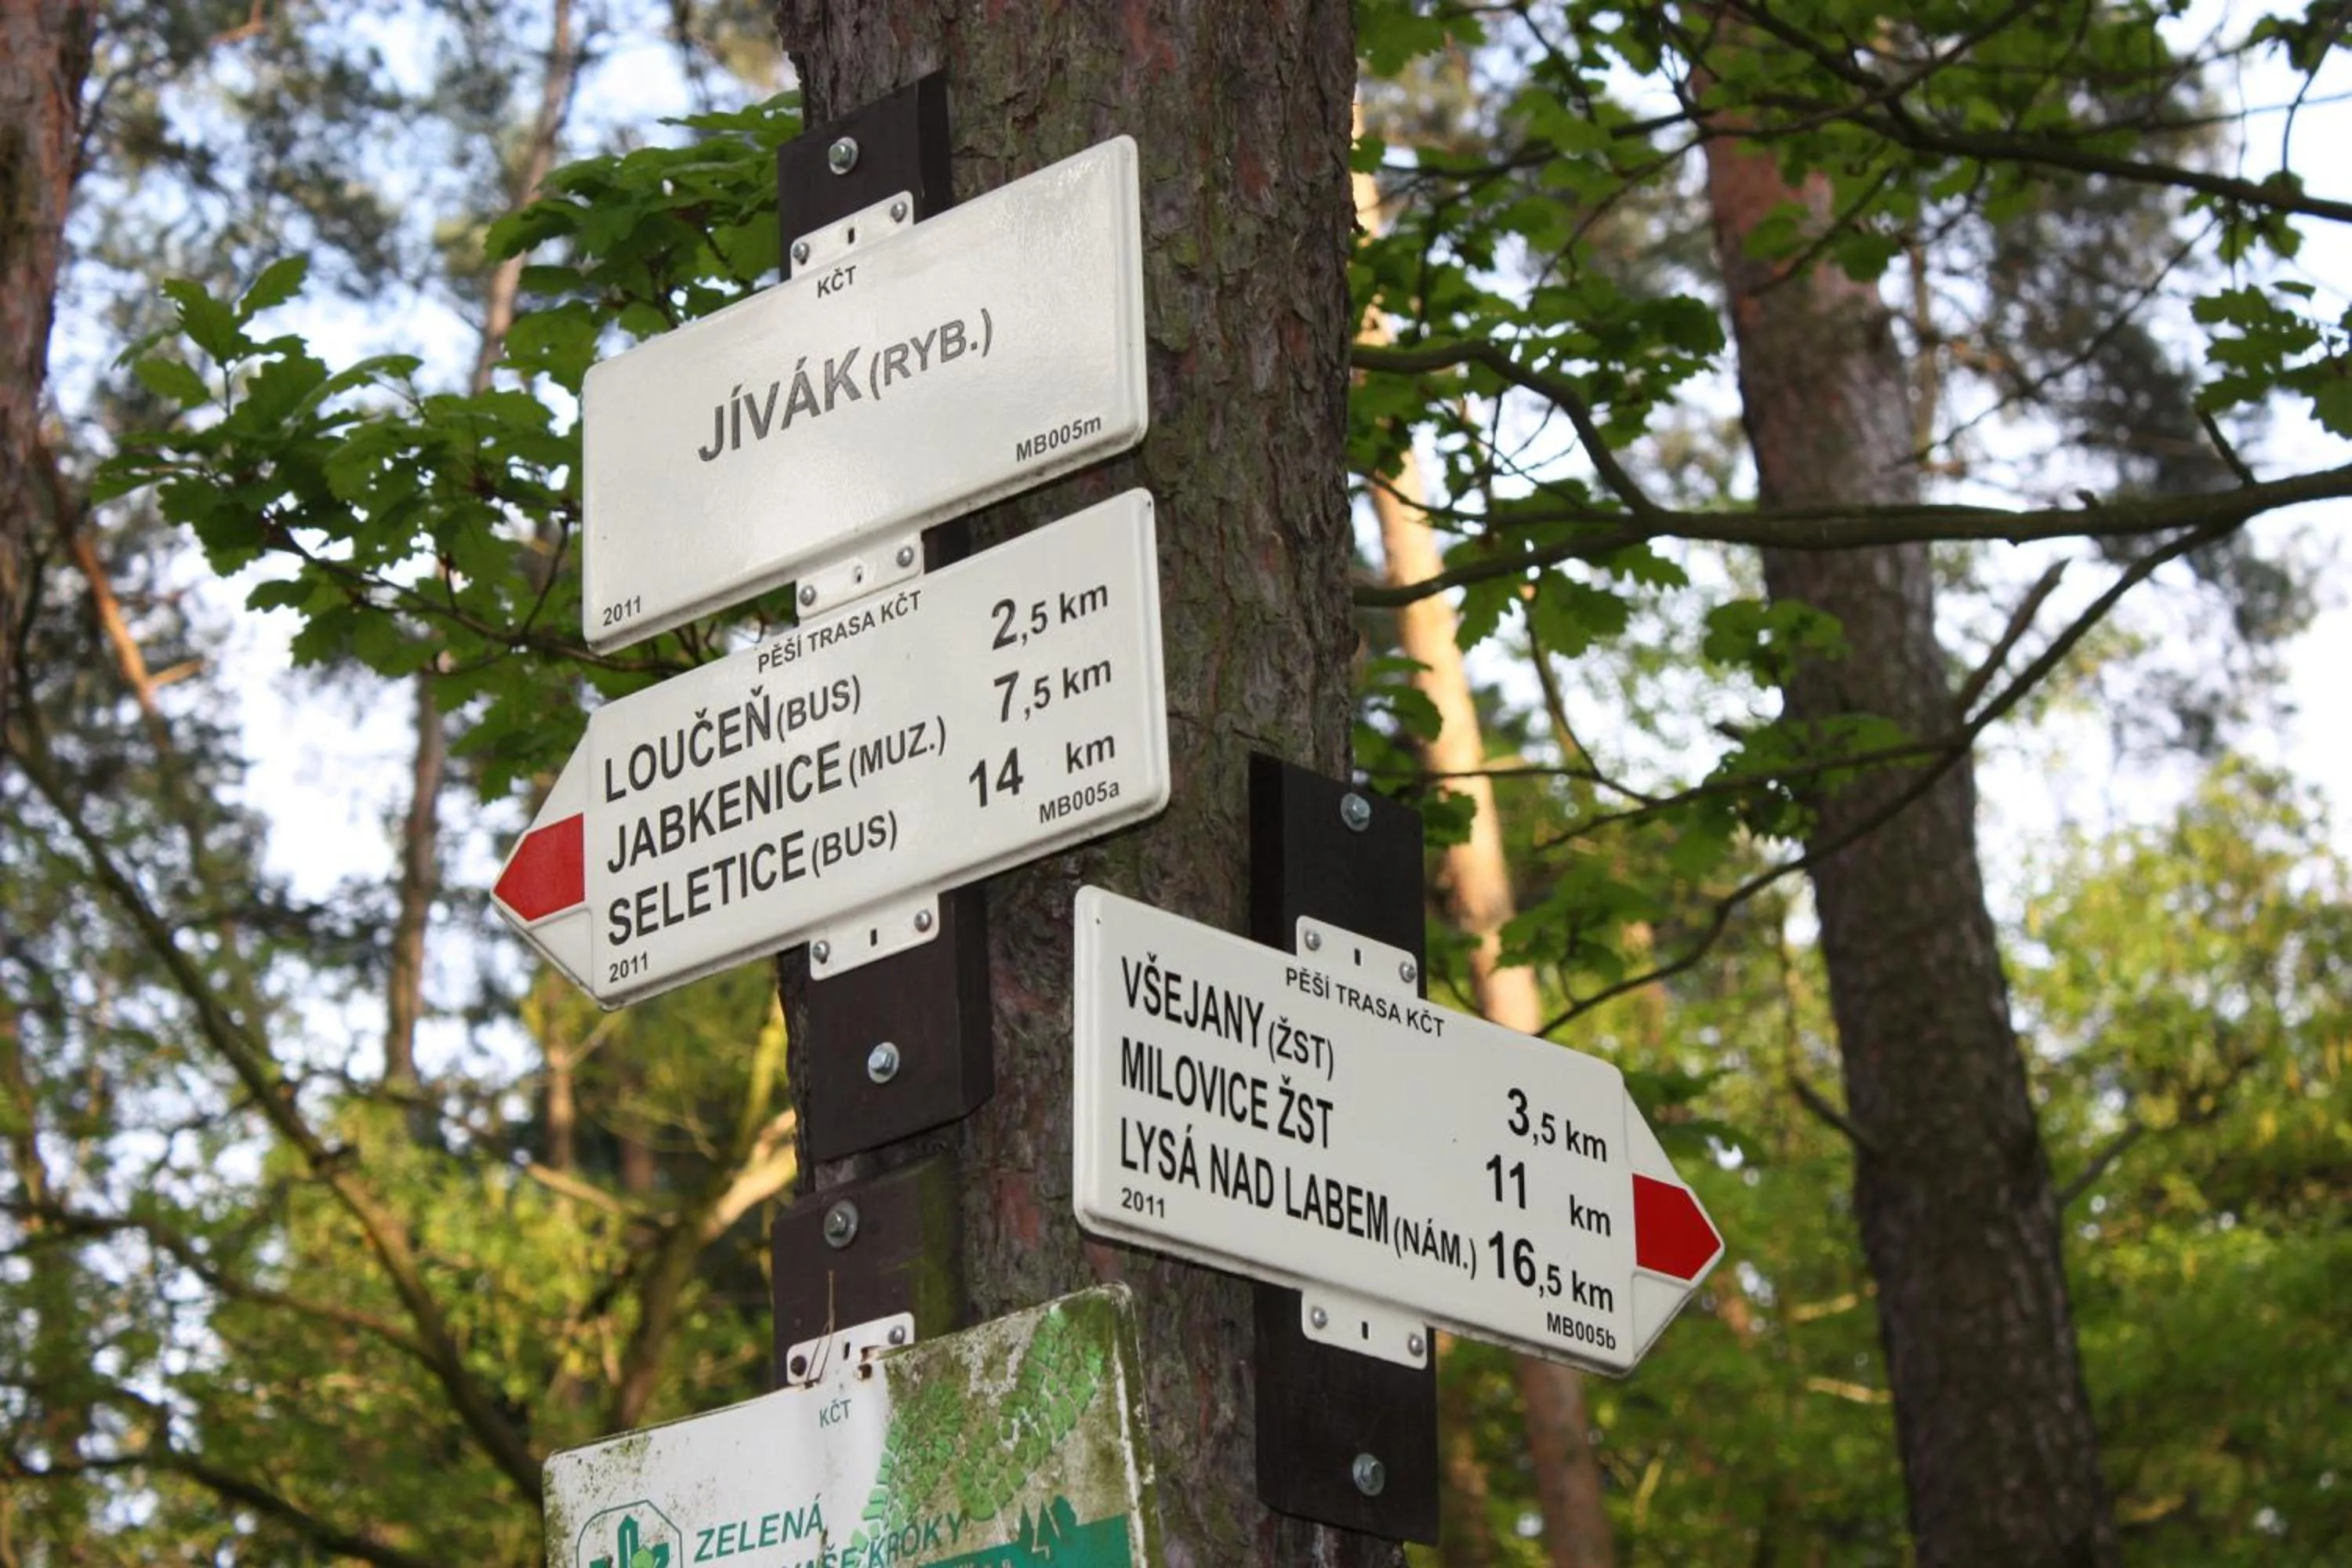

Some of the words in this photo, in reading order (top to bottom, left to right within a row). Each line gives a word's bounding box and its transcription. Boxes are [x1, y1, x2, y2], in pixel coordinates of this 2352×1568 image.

[816, 265, 857, 299] KČT
[698, 346, 863, 462] JÍVÁK
[869, 308, 994, 400] (RYB.)
[1015, 413, 1102, 463] MB005m
[602, 596, 641, 626] 2011
[757, 639, 803, 676] PĚŠÍ
[807, 612, 876, 655] TRASA
[879, 590, 922, 621] KČT
[605, 684, 771, 804] LOUČEŇ
[777, 674, 862, 742] (BUS)
[991, 598, 1048, 652] 2,5
[1058, 583, 1109, 625] km
[607, 742, 841, 875] JABKENICE
[849, 715, 946, 787] (MUZ.)
[993, 670, 1052, 723] 7,5
[1062, 659, 1112, 699] km
[1039, 781, 1120, 824] MB005a
[608, 832, 806, 947] SELETICE
[812, 810, 898, 877] (BUS)
[968, 747, 1024, 808] 14
[1065, 735, 1116, 775] km
[608, 952, 650, 983] 2011
[1286, 967, 1330, 1000] PĚŠÍ
[1336, 985, 1401, 1024] TRASA
[1406, 1008, 1444, 1038] KČT
[1121, 952, 1264, 1049] VŠEJANY
[1268, 1016, 1335, 1081] (ŽST)
[1508, 1087, 1556, 1146] 3,5
[1566, 1120, 1608, 1162] km
[1121, 1036, 1268, 1130] MILOVICE
[1279, 1076, 1334, 1150] ŽST
[1486, 1154, 1528, 1210] 11
[1570, 1195, 1612, 1237] km
[1121, 1187, 1167, 1219] 2011
[1121, 1116, 1200, 1190] LYSÁ
[1210, 1143, 1274, 1210] NAD
[1286, 1166, 1389, 1247] LABEM
[1394, 1215, 1477, 1279] (NÁM.)
[1488, 1229, 1563, 1298] 16,5
[1572, 1271, 1614, 1313] km
[1547, 1312, 1617, 1351] MB005b
[818, 1398, 852, 1428] KČT
[693, 1492, 824, 1563] ZELENÁ
[868, 1510, 966, 1567] KROKY
